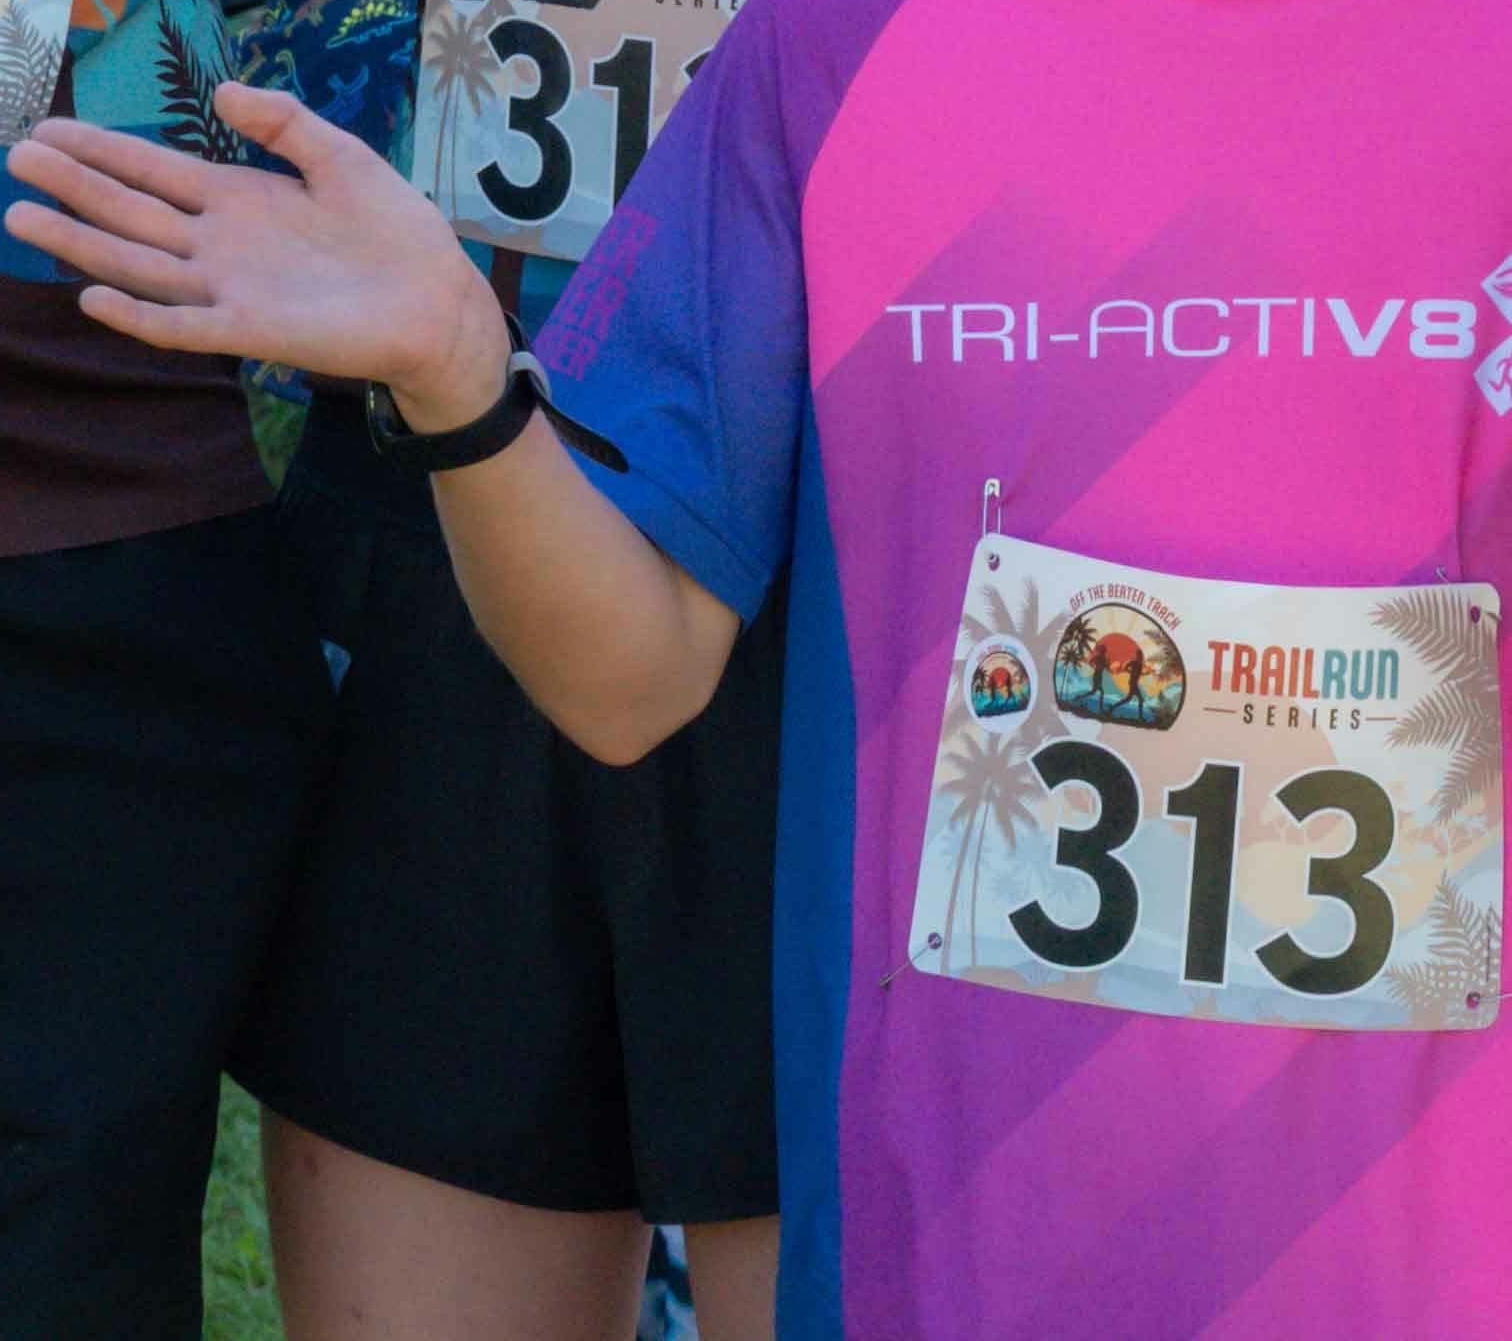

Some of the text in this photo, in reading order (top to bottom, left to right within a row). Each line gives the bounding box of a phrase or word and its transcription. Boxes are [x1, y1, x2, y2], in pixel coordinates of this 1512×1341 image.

[476, 17, 714, 223] 31
[885, 296, 1478, 363] TRI-ACTIV8
[1069, 582, 1183, 632] OFF THE BEATEN TRACK
[1207, 639, 1400, 702] TRAILRUN
[1243, 702, 1362, 731] SERIES
[1008, 740, 1396, 997] 313
